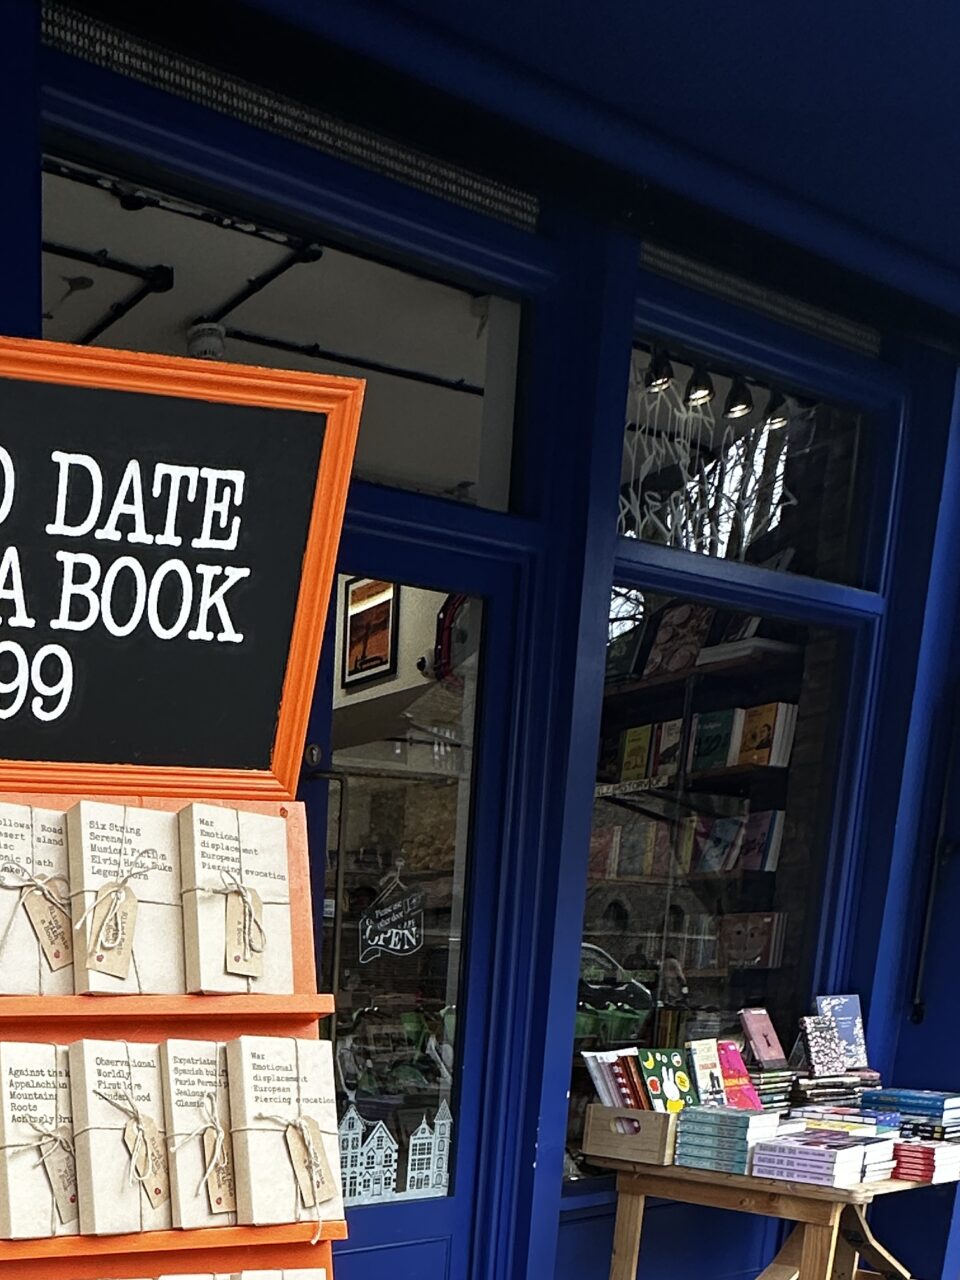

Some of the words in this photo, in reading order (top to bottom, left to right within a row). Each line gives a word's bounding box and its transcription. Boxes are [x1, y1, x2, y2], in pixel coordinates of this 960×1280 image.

[45, 449, 246, 550] DATE
[50, 552, 250, 643] BOOK
[199, 818, 214, 827] War
[41, 824, 63, 834] Road
[90, 821, 106, 831] Six
[110, 824, 141, 837] String
[201, 852, 240, 864] European
[245, 870, 286, 881] evocation
[173, 1056, 217, 1066] Expatriates
[251, 1052, 265, 1060] War
[9, 1067, 45, 1078] Against
[174, 1067, 204, 1076] Spanish
[252, 1064, 293, 1072] Emotional
[97, 1069, 131, 1080] Worldly
[9, 1080, 67, 1089] Appalachian
[98, 1080, 121, 1089] First
[253, 1085, 291, 1094] European
[175, 1100, 205, 1108] Classic
[255, 1095, 291, 1105] Piercing
[11, 1103, 37, 1112] Roots
